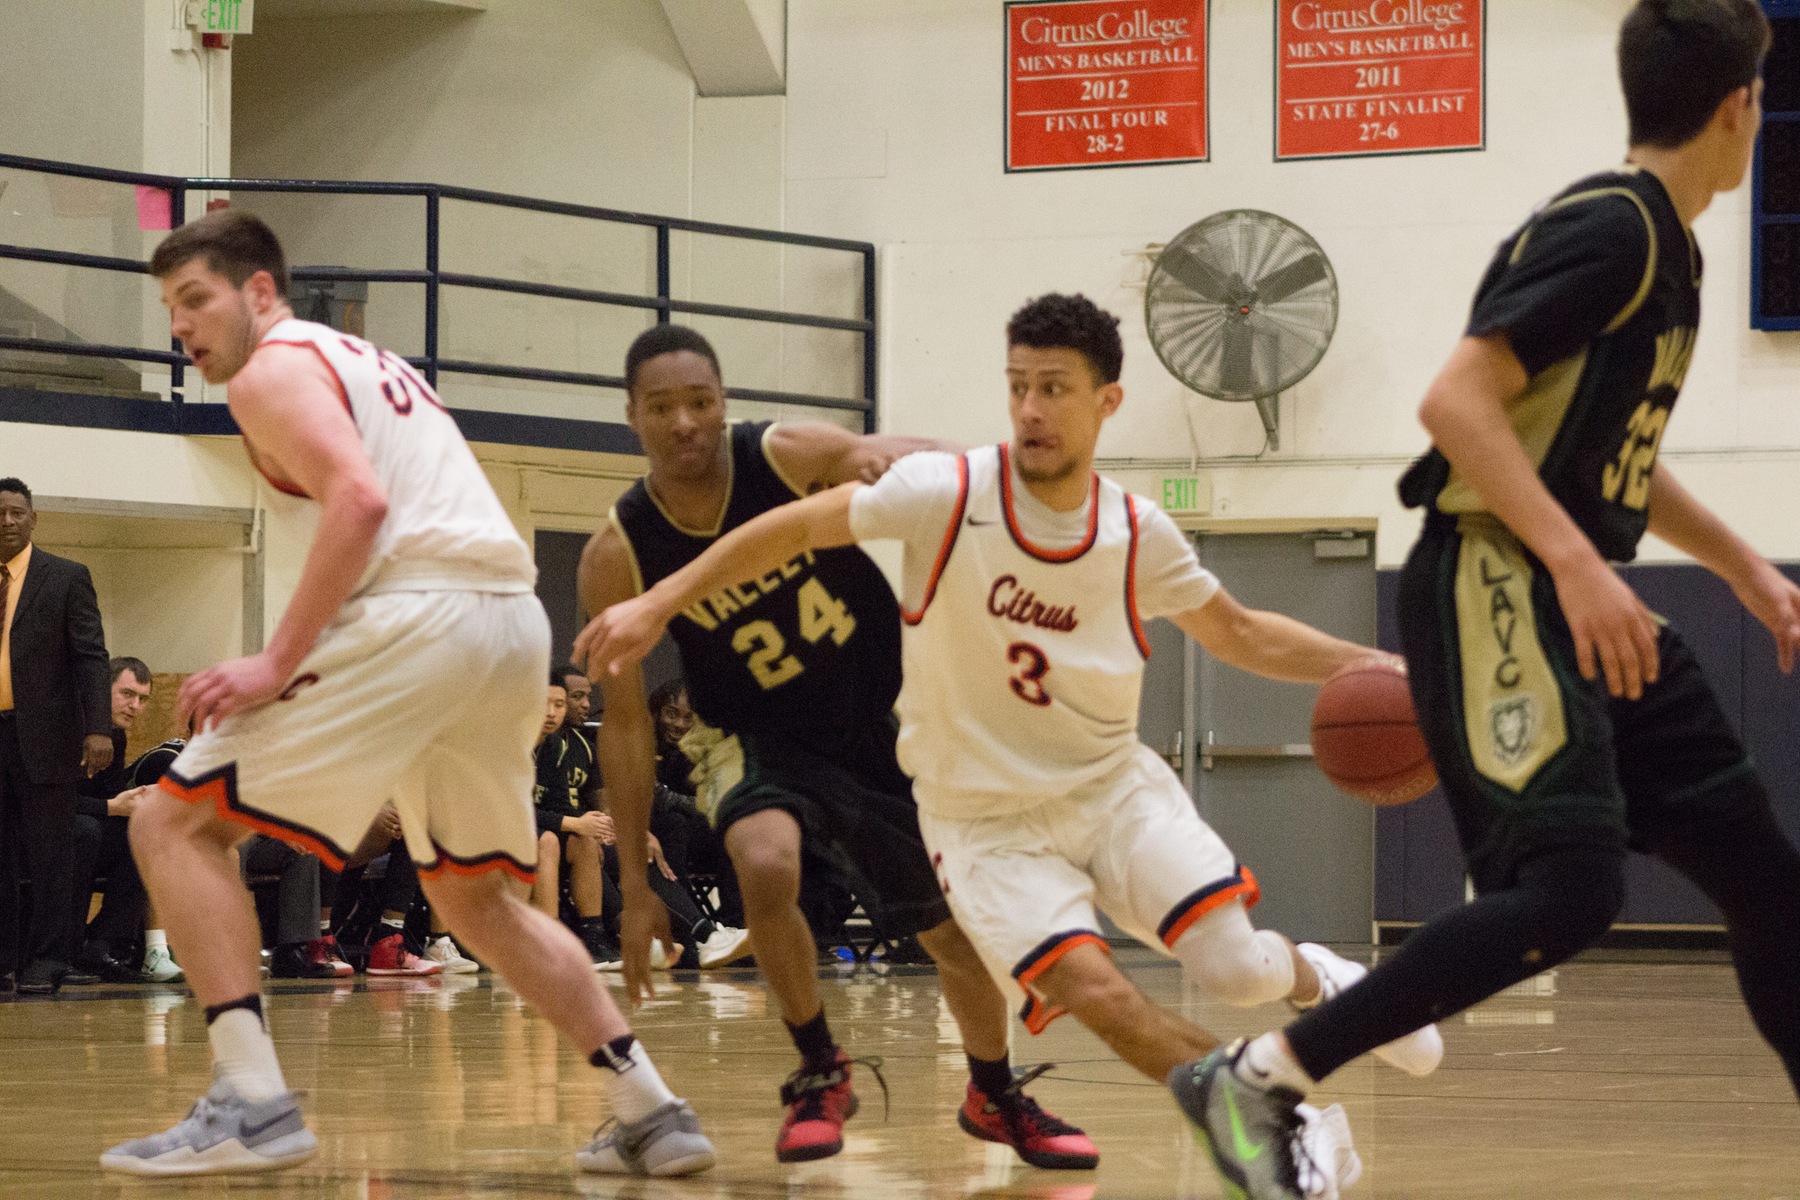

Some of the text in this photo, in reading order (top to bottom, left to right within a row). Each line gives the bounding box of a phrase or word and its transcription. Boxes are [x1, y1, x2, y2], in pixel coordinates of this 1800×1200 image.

[207, 0, 242, 30] EXIT
[1287, 32, 1473, 58] MEN'S BASKETBALL
[1018, 47, 1198, 72] MEN'S BASKETBALL
[1080, 78, 1129, 101] 2012
[1355, 66, 1401, 88] 2011
[1045, 110, 1168, 132] FINAL FOUR
[1293, 95, 1466, 121] STATE FINALIST
[1087, 133, 1125, 153] 28-2
[1359, 121, 1399, 142] 27-6
[1163, 478, 1198, 508] EXIT
[987, 573, 1079, 633] Citrus
[732, 576, 857, 690] 24
[1007, 641, 1052, 707] 3
